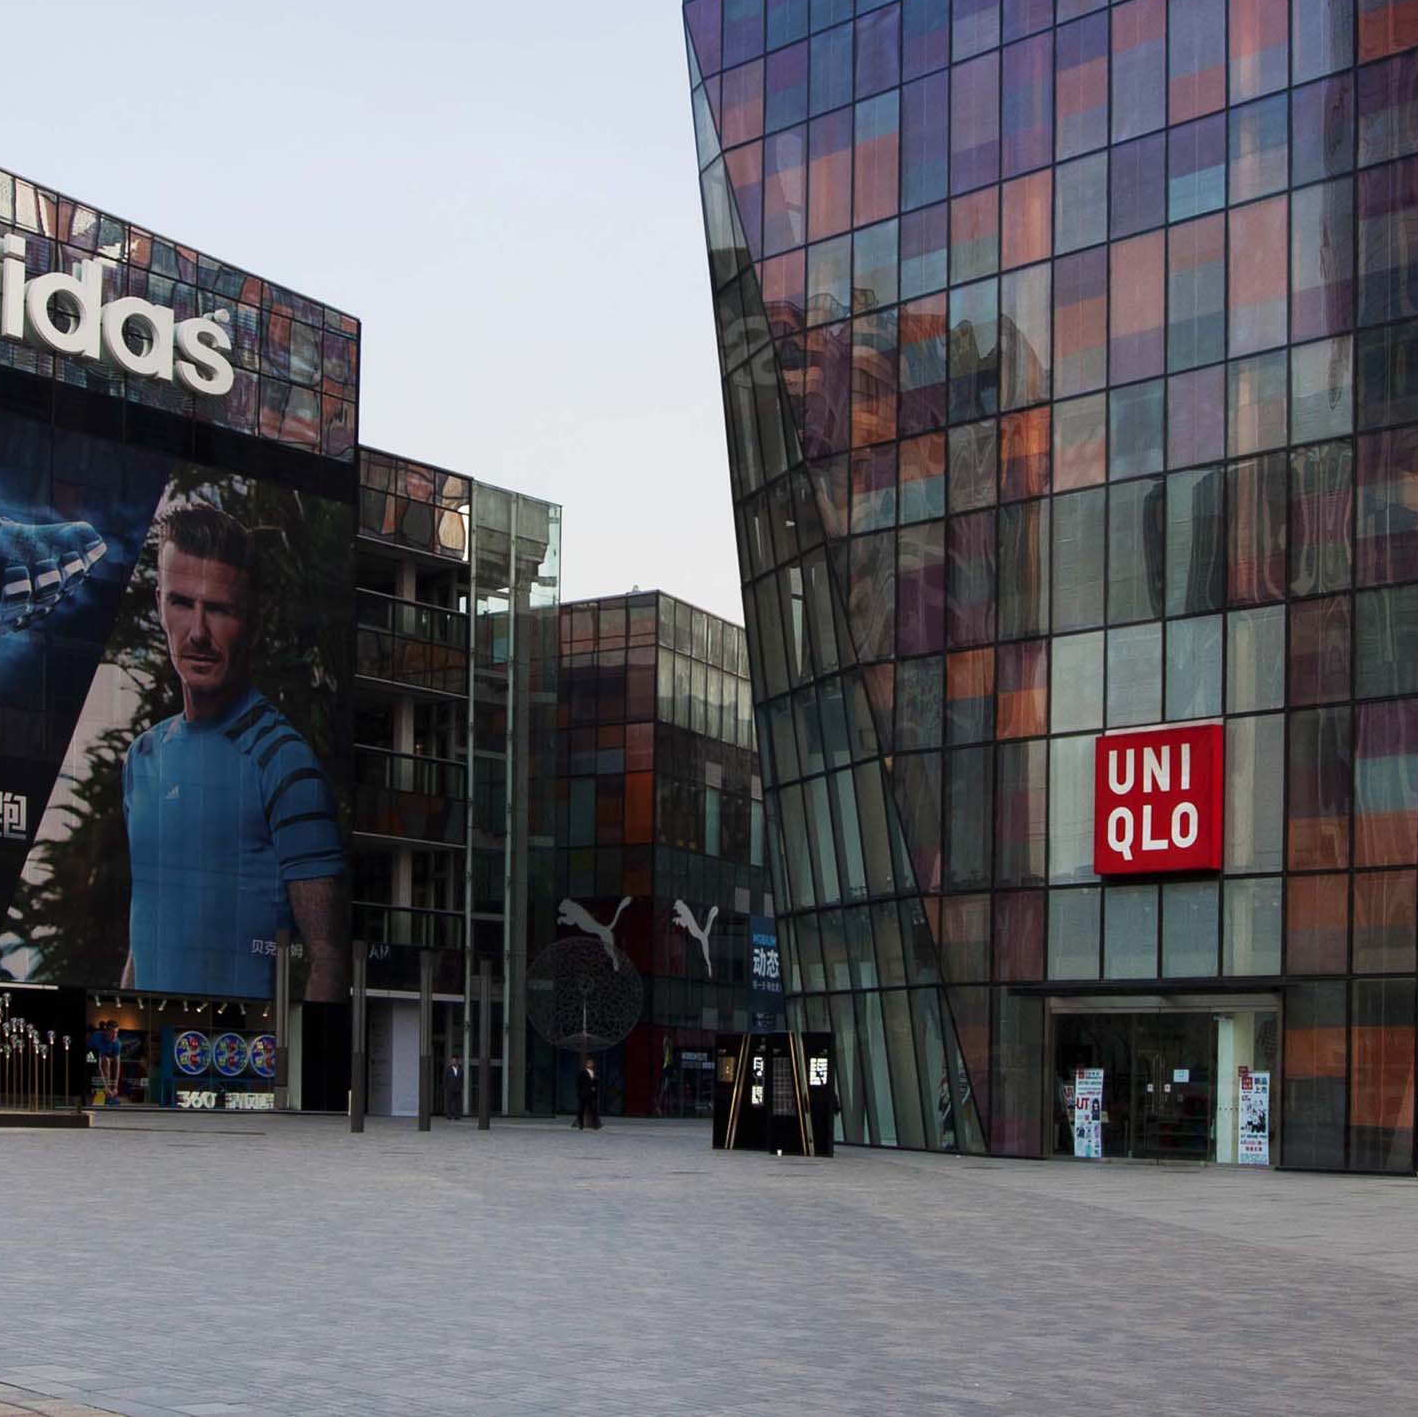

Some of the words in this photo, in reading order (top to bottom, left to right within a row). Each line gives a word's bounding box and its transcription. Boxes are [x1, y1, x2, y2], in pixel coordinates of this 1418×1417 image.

[1108, 743, 1191, 795] UNI
[1107, 801, 1199, 861] QLO
[251, 939, 304, 958] 贝克姆
[752, 948, 780, 977] 动态
